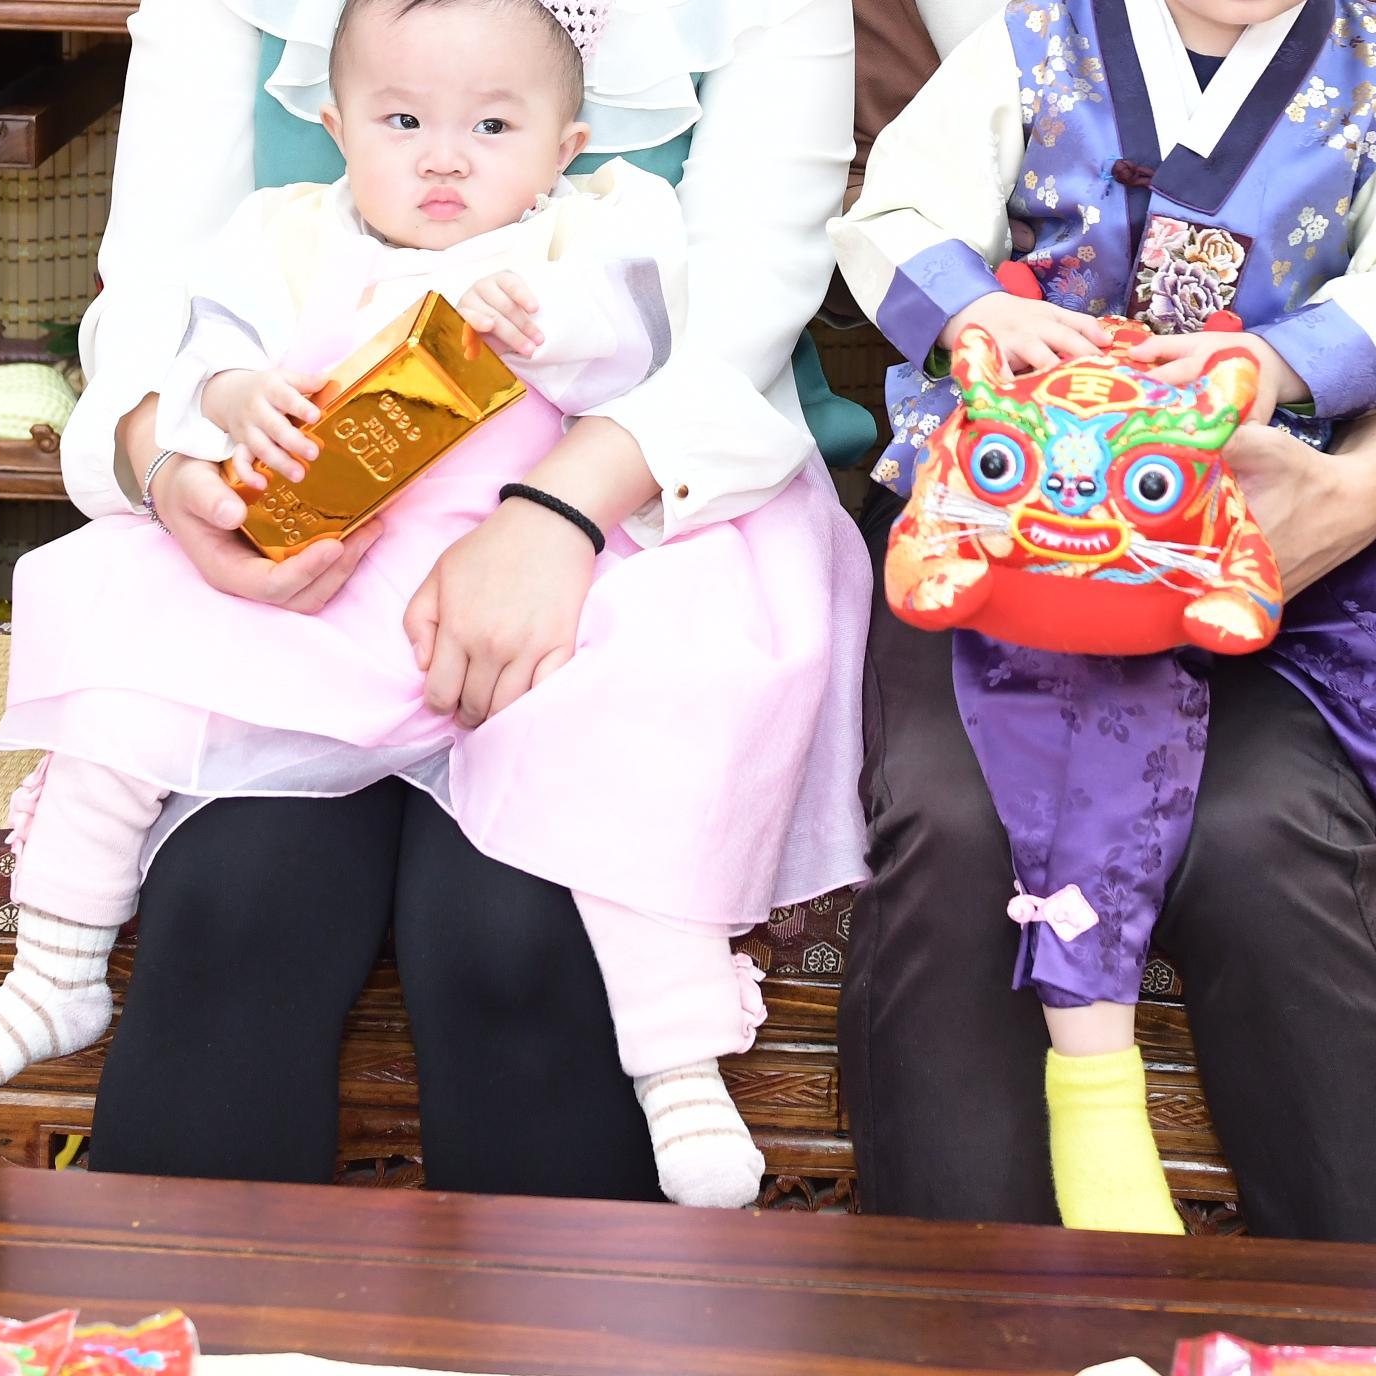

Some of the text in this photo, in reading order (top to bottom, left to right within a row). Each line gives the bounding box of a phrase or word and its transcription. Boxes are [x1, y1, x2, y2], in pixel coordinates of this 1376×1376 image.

[1066, 374, 1114, 403] 王
[362, 417, 400, 454] FINE
[379, 393, 421, 441] 999.9
[334, 418, 395, 482] GOLD
